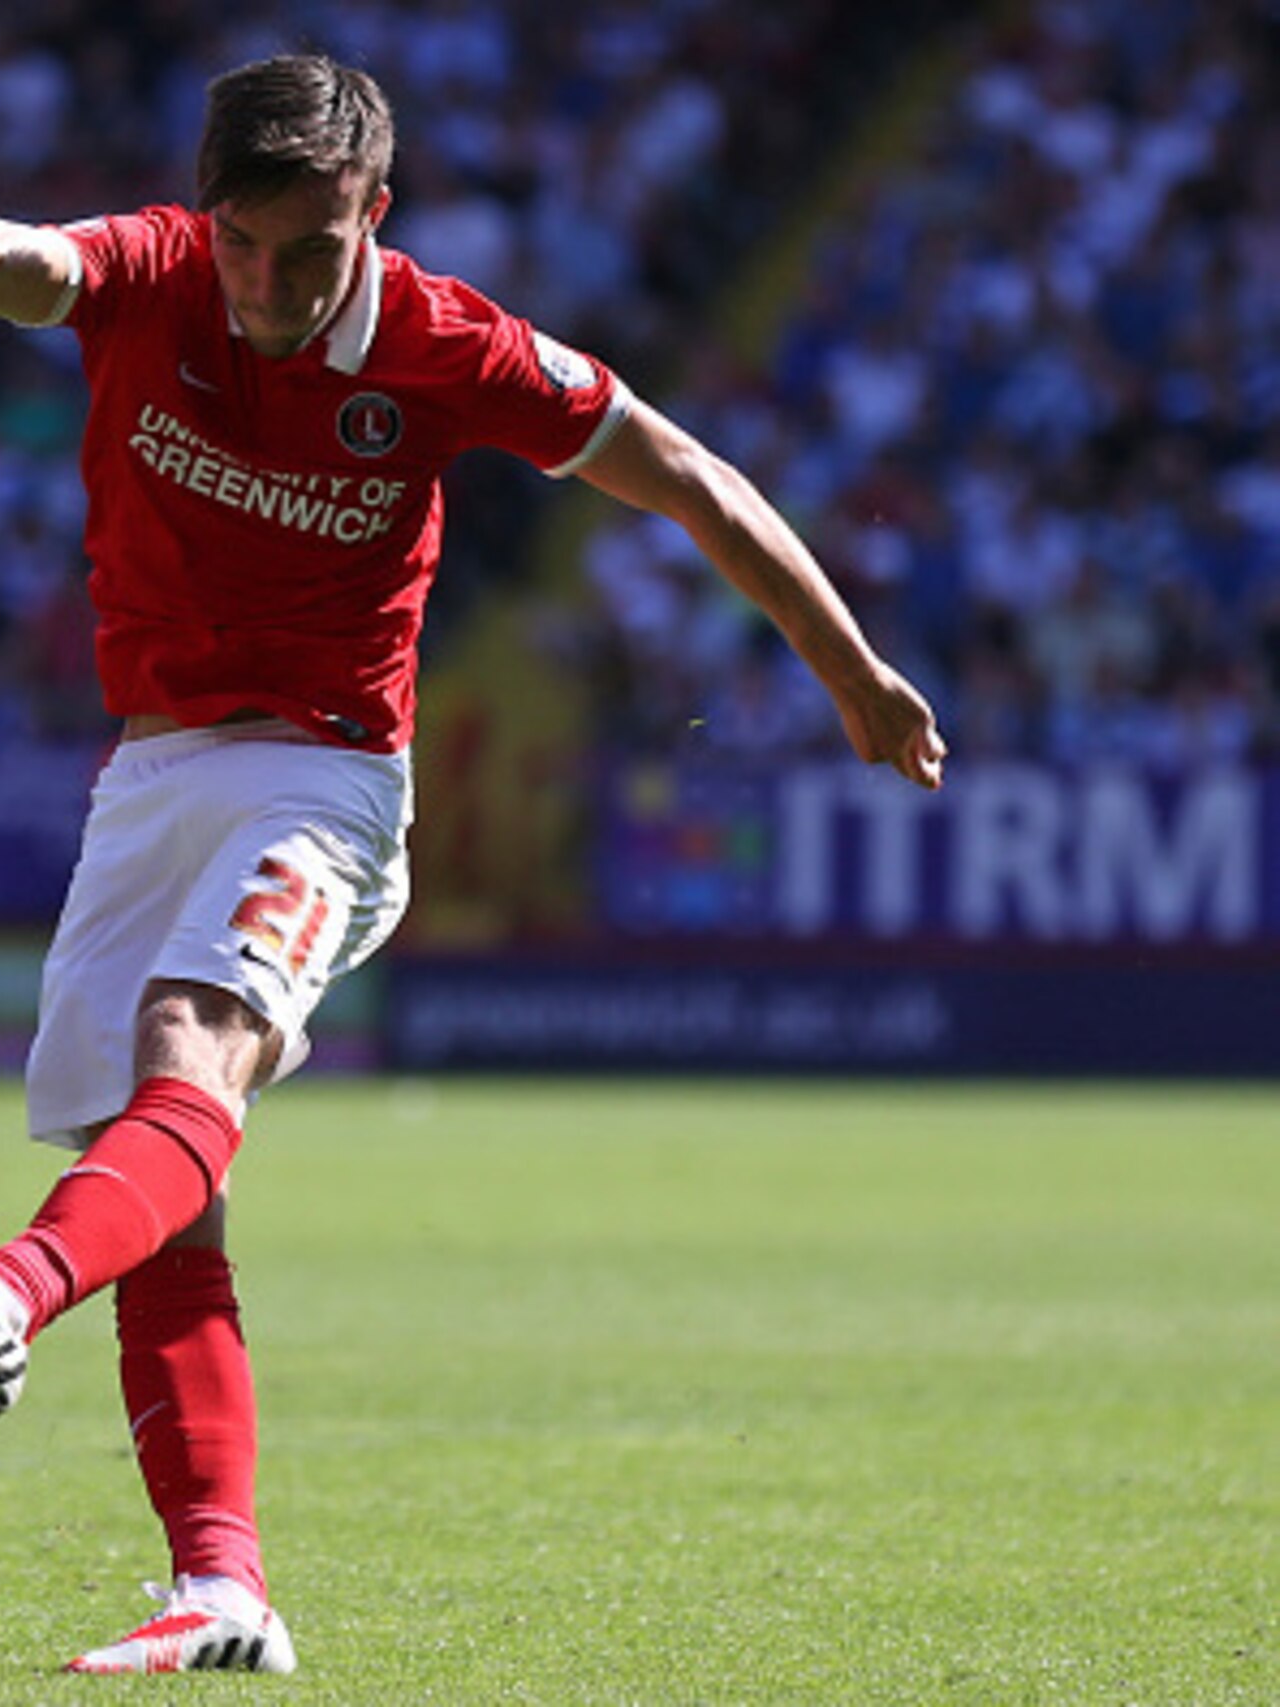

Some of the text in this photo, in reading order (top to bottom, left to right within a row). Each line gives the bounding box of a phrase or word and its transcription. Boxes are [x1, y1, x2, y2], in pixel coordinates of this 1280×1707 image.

[128, 433, 394, 544] GREENWICH
[138, 402, 354, 500] UNITY
[360, 477, 407, 510] OF
[782, 765, 1262, 940] ITRM
[228, 855, 330, 978] 21
